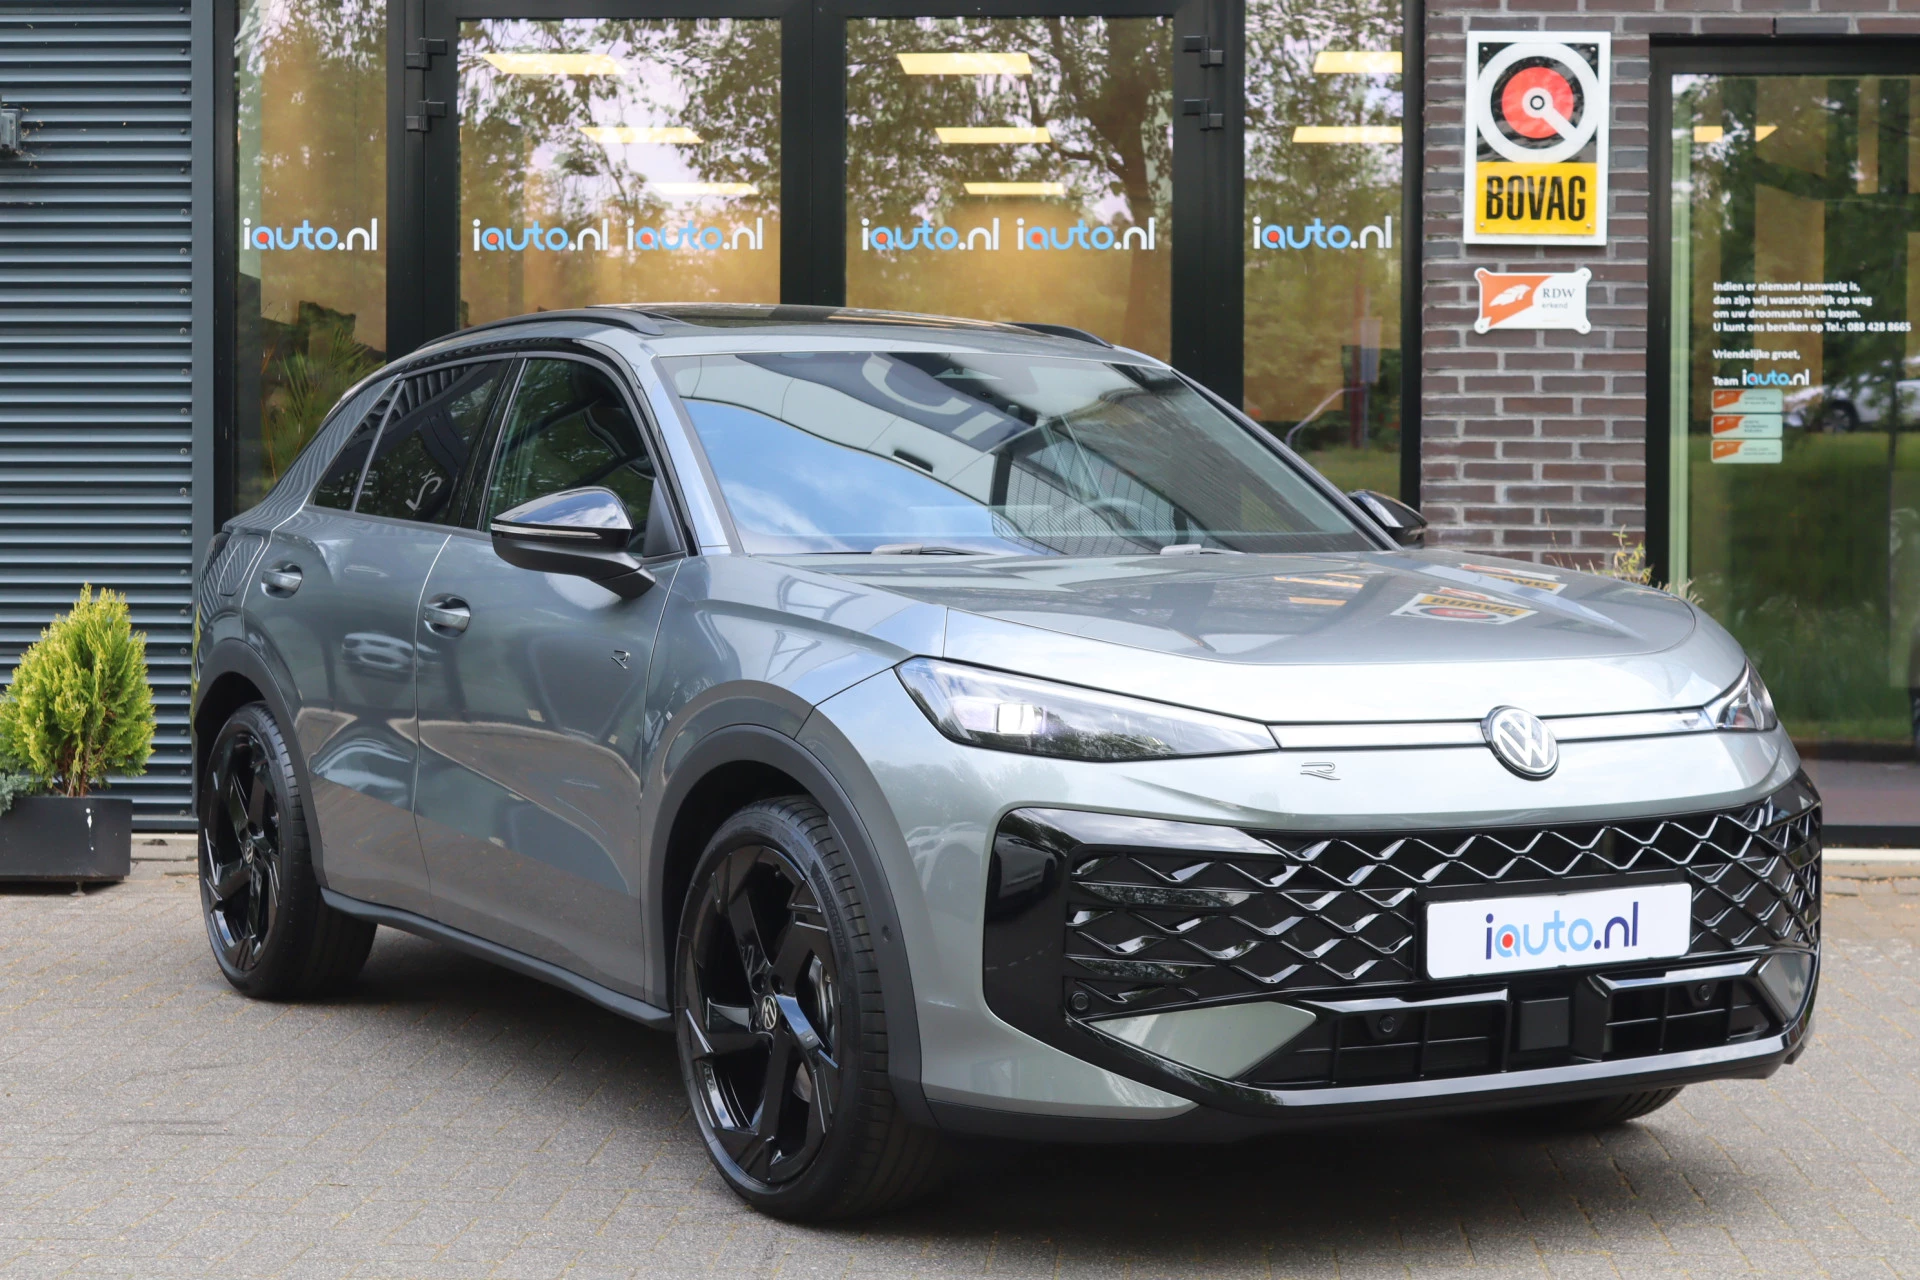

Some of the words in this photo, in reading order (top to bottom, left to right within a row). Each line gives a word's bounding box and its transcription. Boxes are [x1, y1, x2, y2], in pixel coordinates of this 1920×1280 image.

[1486, 175, 1586, 221] BOVAG
[243, 217, 378, 251] iauto.nl
[472, 218, 608, 251] iauto.nl
[627, 217, 763, 250] iauto.nl
[861, 217, 1000, 251] iauto.nl
[1016, 217, 1155, 250] iauto.nl
[1252, 215, 1392, 250] iauto.nl
[1542, 288, 1576, 299] RDW
[1713, 281, 1744, 291] Indien
[1745, 283, 1757, 291] er
[1758, 281, 1801, 291] niemand
[1802, 281, 1848, 293] aanwezig
[1849, 281, 1860, 292] is,
[1541, 302, 1568, 310] erkend
[1713, 295, 1732, 305] dan
[1733, 295, 1751, 307] zijn
[1752, 295, 1768, 307] wij
[1769, 295, 1835, 307] waarschijnlijk
[1836, 297, 1850, 306] op
[1851, 297, 1873, 307] weg
[1713, 310, 1730, 318] om
[1731, 310, 1747, 318] uw
[1748, 308, 1803, 318] droomauto
[1804, 308, 1814, 318] in
[1815, 309, 1826, 318] te
[1827, 308, 1861, 320] kopen.
[1713, 322, 1721, 332] U
[1722, 321, 1746, 332] kunt
[1746, 323, 1765, 332] ons
[1766, 321, 1809, 332] bereiken
[1810, 323, 1824, 334] op
[1825, 322, 1846, 332] Tel.:
[1846, 321, 1866, 332] 088
[1867, 321, 1886, 332] 428
[1712, 349, 1770, 361] Vriendelijke
[1771, 350, 1801, 361] groet,
[1712, 376, 1739, 386] Team
[1742, 368, 1810, 386] iauto.nl
[1485, 901, 1639, 960] iauto.nl
